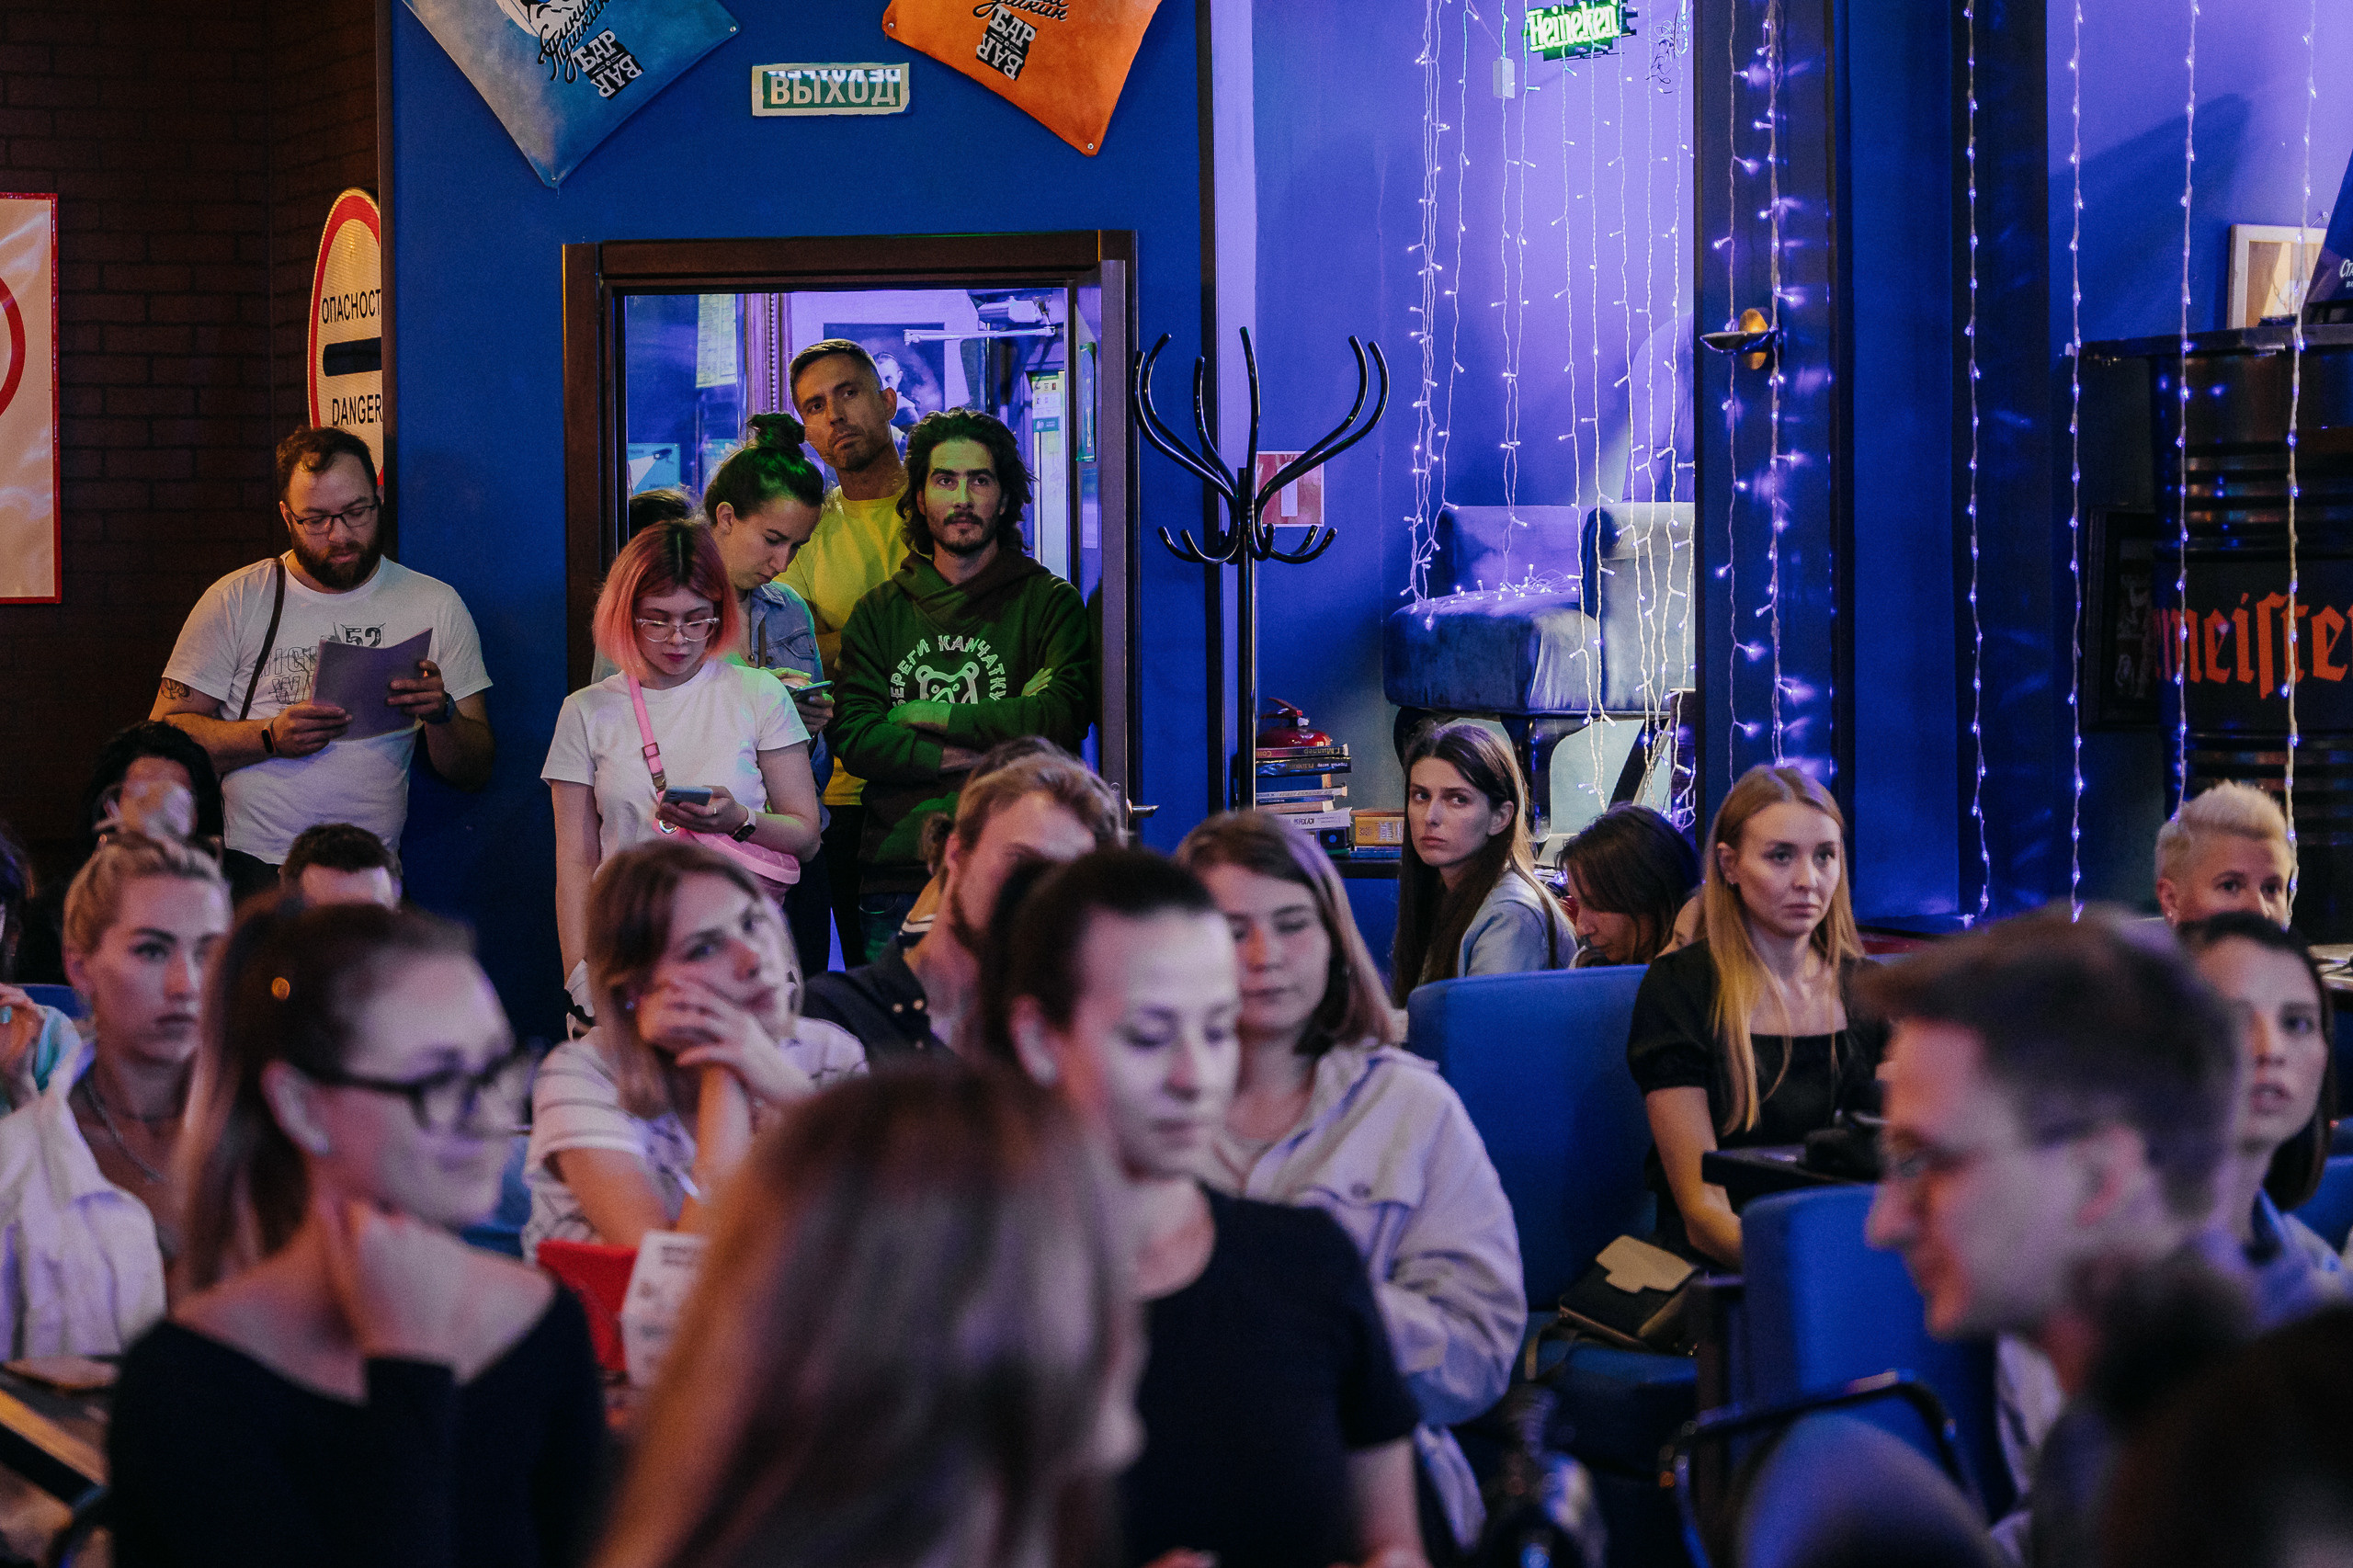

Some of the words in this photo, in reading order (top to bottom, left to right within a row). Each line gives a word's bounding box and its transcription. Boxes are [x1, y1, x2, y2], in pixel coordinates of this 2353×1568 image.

[988, 5, 1036, 48] БАР
[1527, 0, 1620, 51] Heineken
[573, 30, 617, 73] БАР
[976, 33, 1023, 80] BAR
[590, 55, 642, 97] BAR
[770, 74, 896, 106] ВЫХОД
[322, 288, 381, 324] ОПАСНОСТ
[332, 393, 382, 426] DANGER
[346, 627, 381, 647] 52
[938, 634, 1006, 701] КАМЧАТКУ
